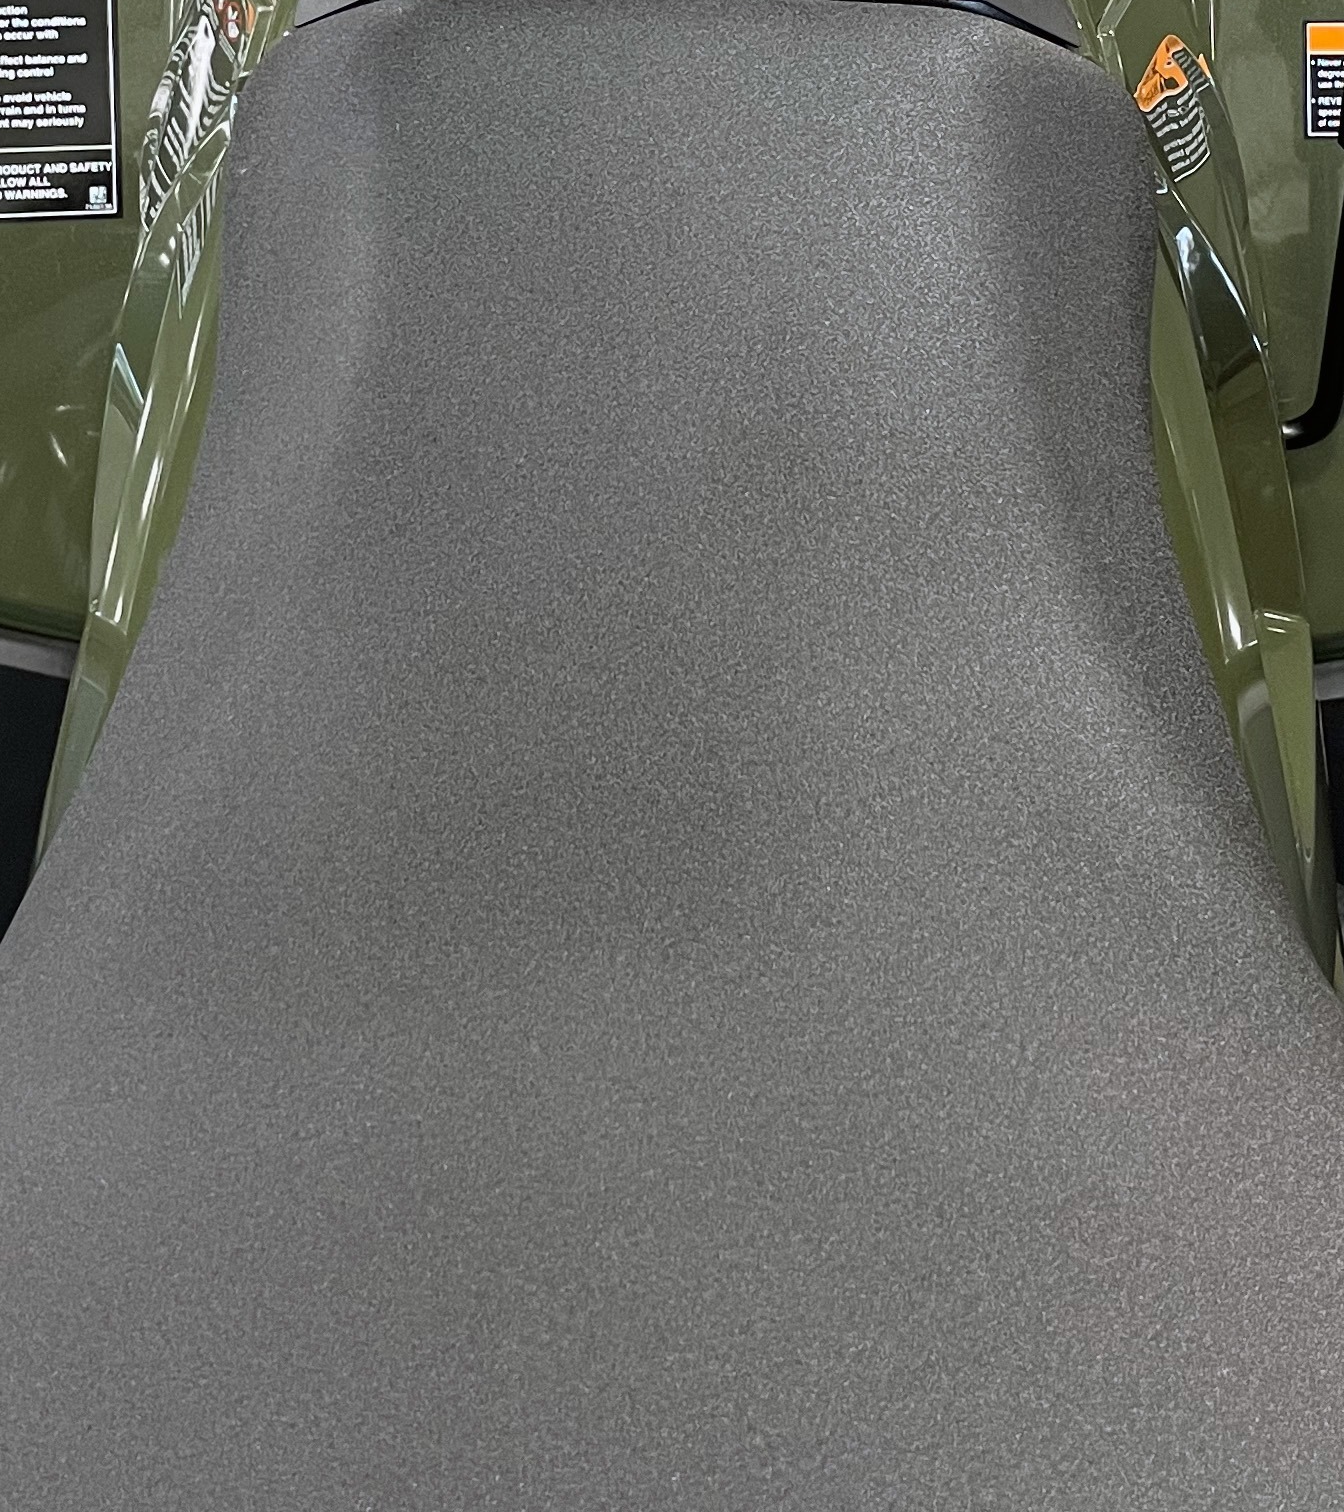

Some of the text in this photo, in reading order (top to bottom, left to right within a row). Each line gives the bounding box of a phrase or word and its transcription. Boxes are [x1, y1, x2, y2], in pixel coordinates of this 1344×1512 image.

[43, 162, 68, 174] AND
[69, 161, 112, 173] SAFETY
[29, 176, 51, 187] ALL
[5, 188, 68, 200] WARNINGS.
